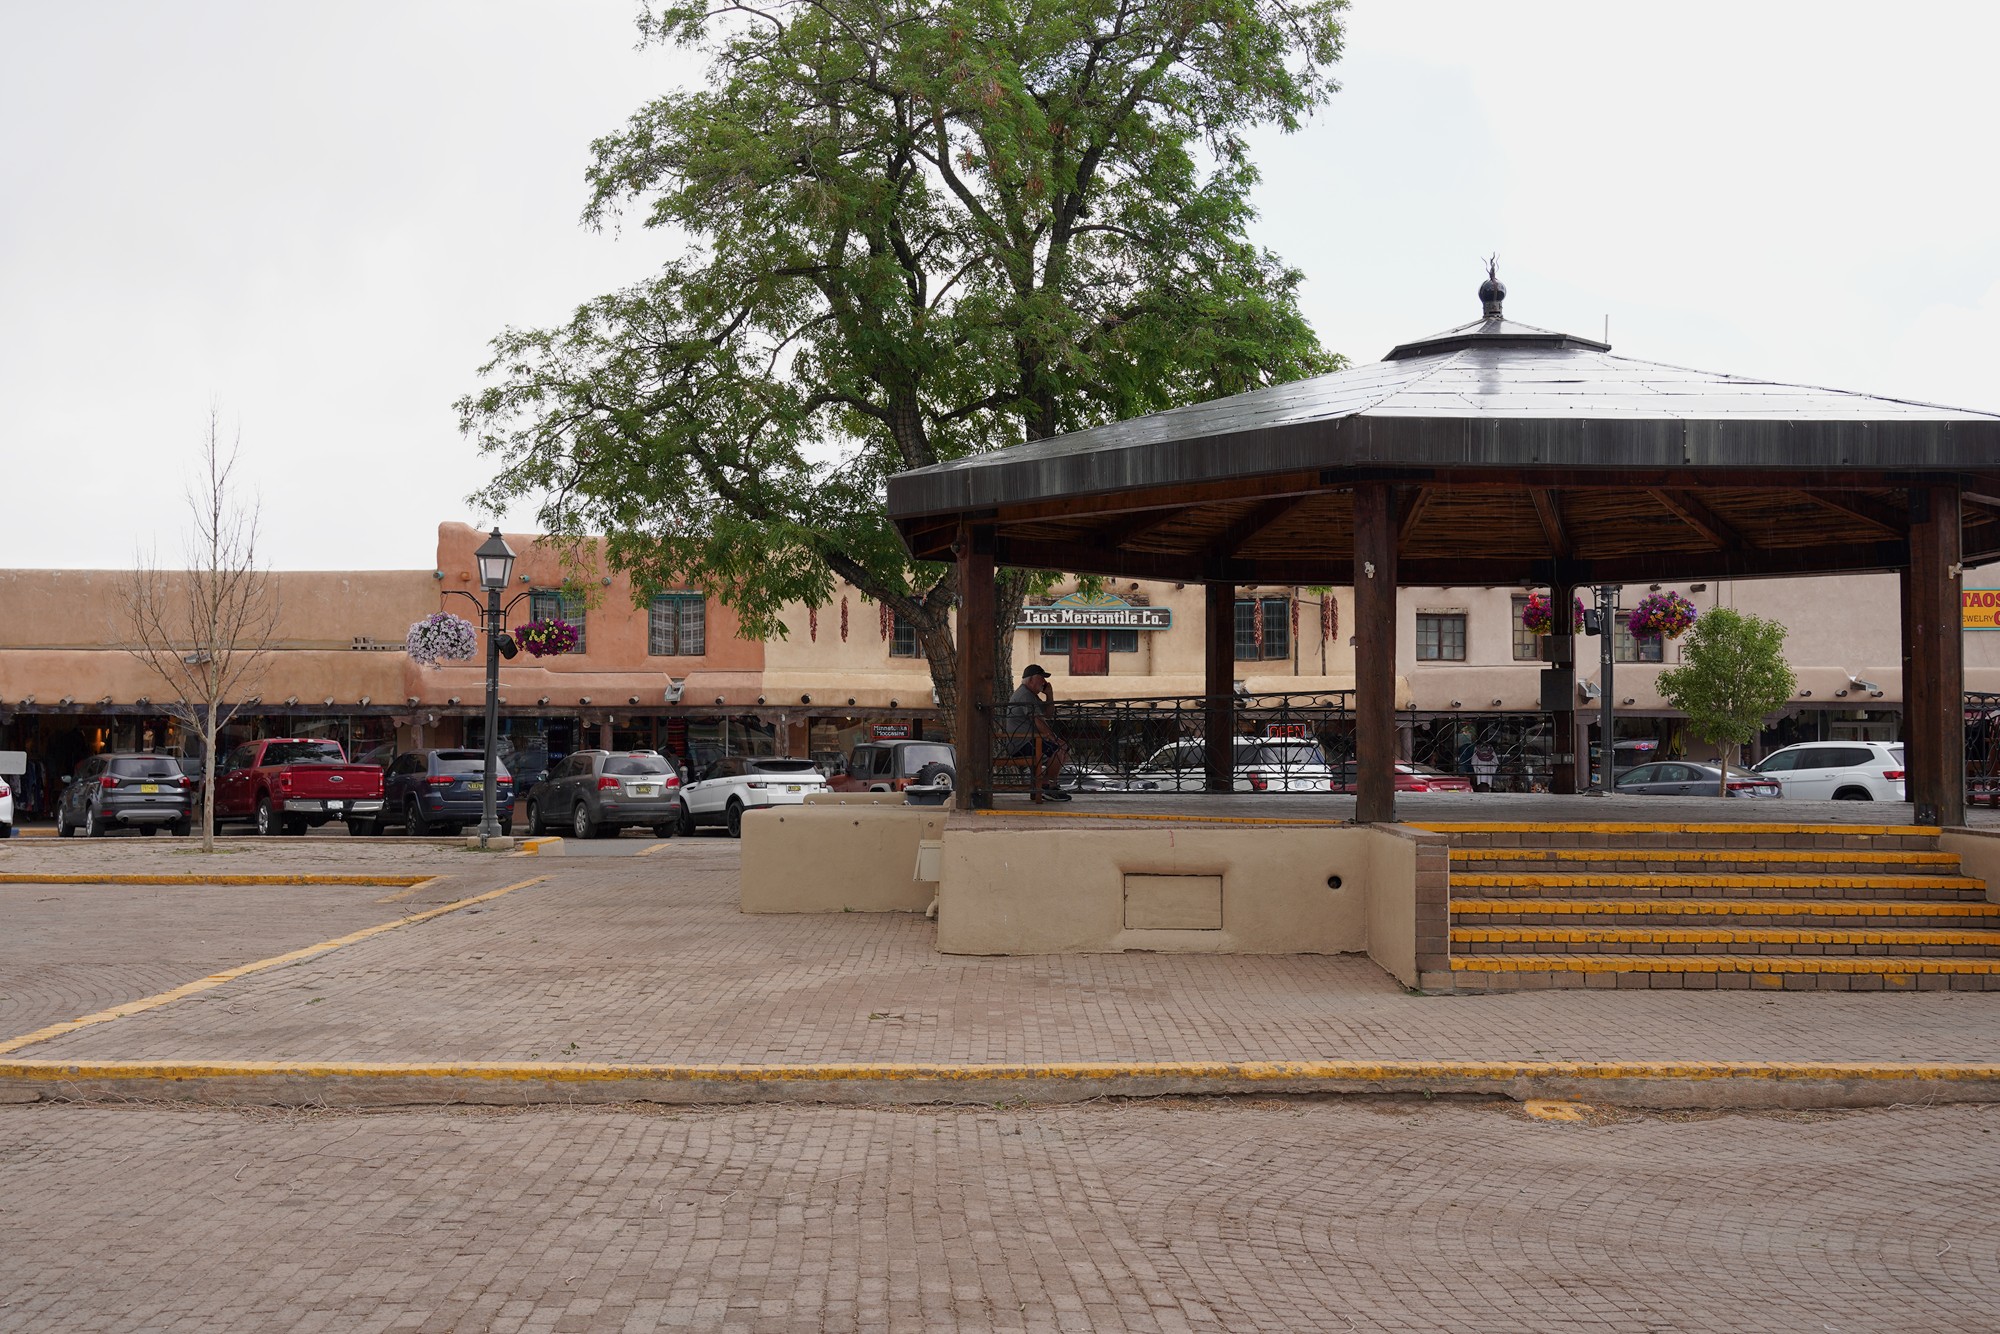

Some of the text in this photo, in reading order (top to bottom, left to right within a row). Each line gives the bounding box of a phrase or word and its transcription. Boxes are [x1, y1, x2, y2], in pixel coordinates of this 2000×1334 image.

[1023, 609, 1163, 625] Taos Mercantile Co.
